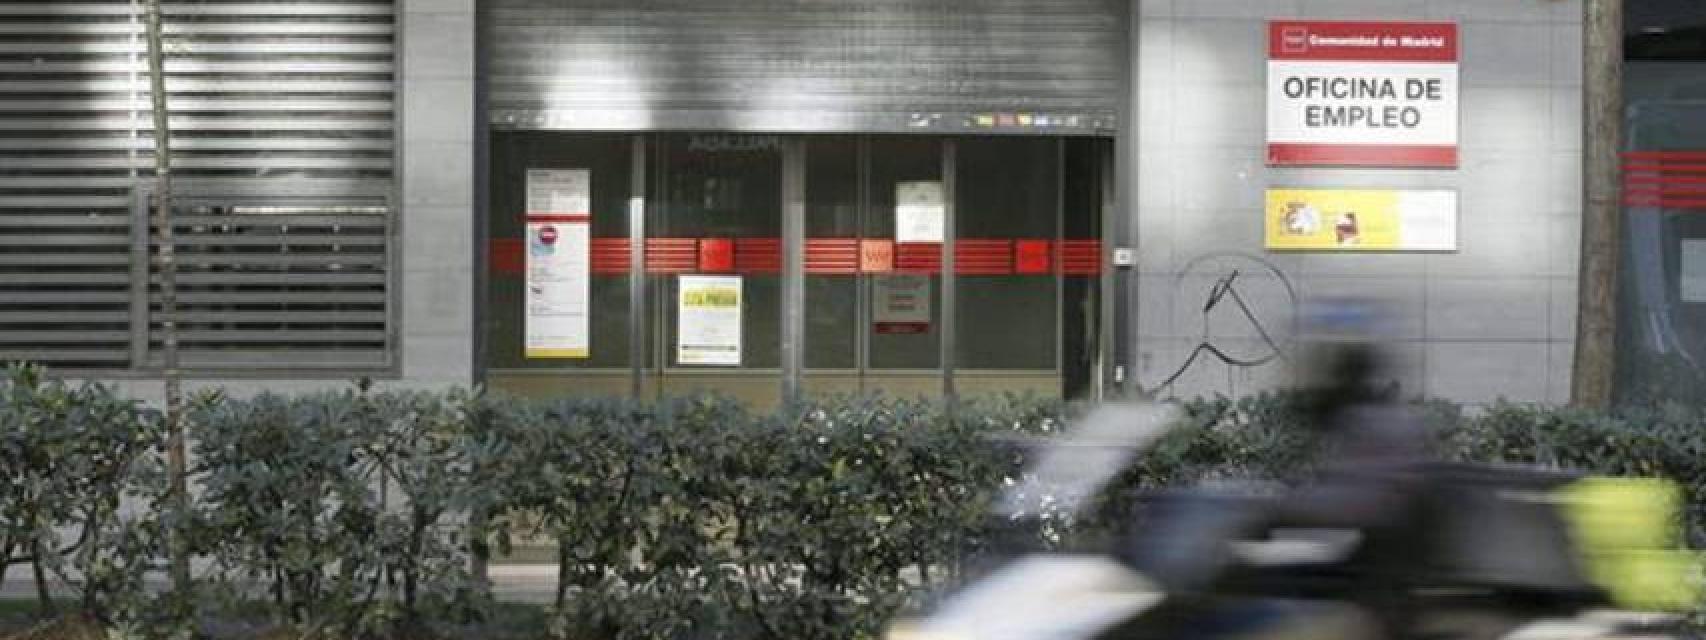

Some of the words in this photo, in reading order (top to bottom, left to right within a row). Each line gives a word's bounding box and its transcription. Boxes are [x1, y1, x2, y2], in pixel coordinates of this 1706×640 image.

[1309, 34, 1379, 47] Comunidad
[1382, 34, 1397, 47] de
[1400, 34, 1445, 47] Madrid
[1284, 76, 1397, 99] OFICINA
[1405, 77, 1442, 100] DE
[1305, 105, 1421, 128] EMPLEO
